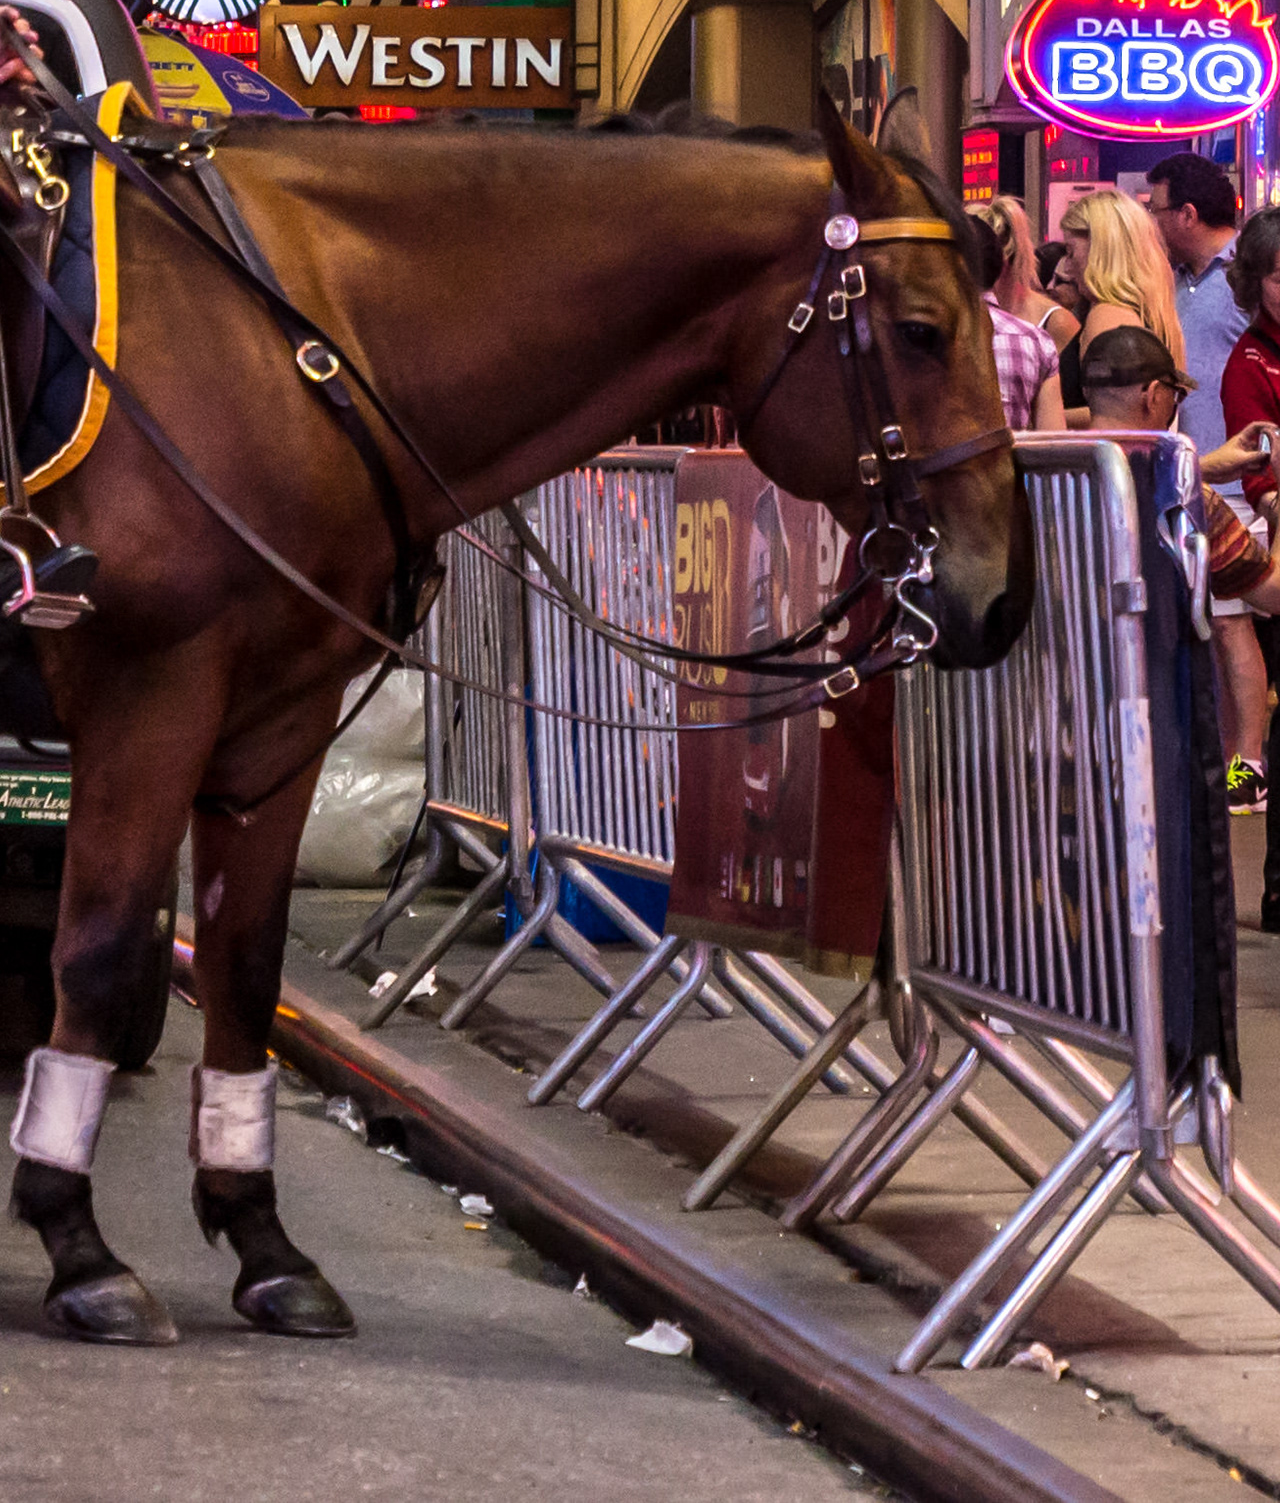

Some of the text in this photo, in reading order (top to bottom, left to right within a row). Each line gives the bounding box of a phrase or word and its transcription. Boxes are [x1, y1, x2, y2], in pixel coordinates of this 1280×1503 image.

[280, 23, 564, 88] WESTIN
[1076, 17, 1232, 39] DALLAS
[1051, 41, 1263, 104] BBQ
[676, 498, 713, 595] BIG
